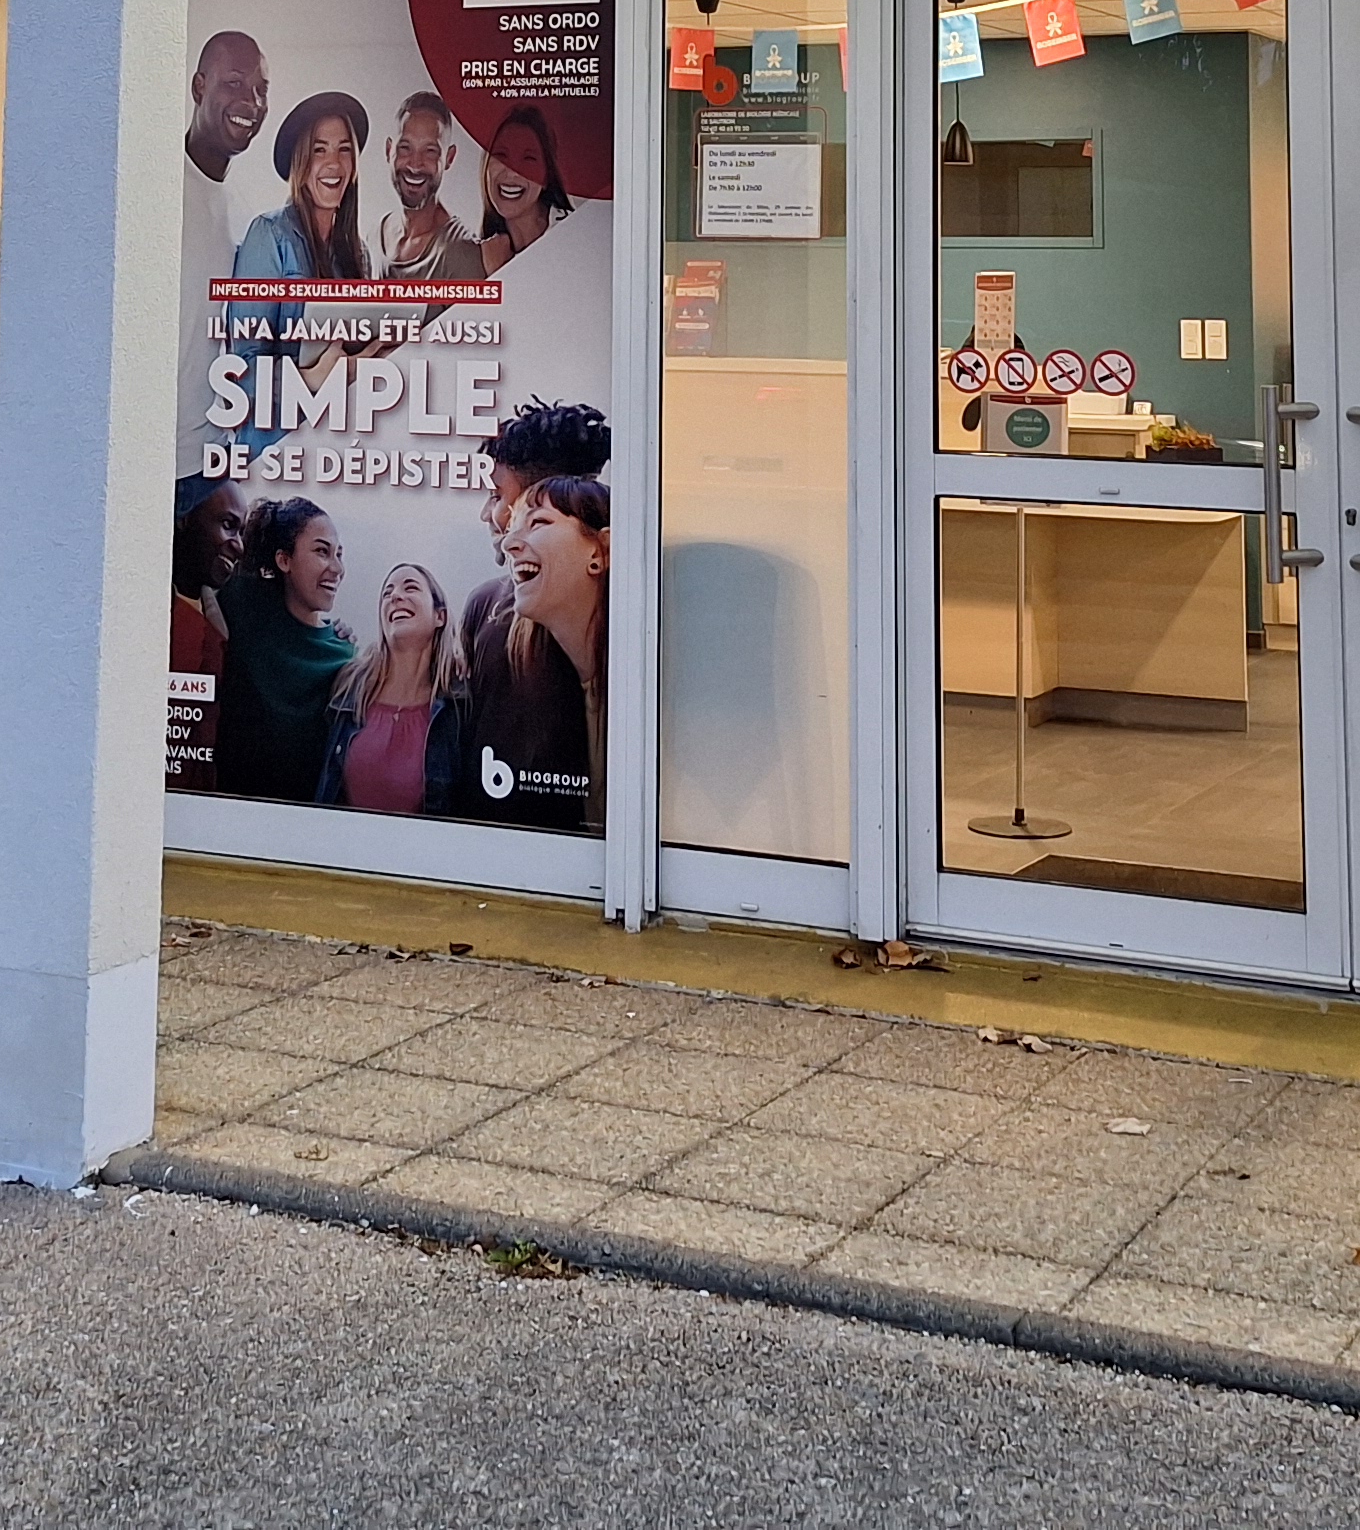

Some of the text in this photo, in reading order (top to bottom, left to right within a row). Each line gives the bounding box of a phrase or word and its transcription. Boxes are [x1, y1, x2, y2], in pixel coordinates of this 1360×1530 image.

[499, 12, 600, 31] SANS ORDO
[513, 35, 600, 53] SANS RDV
[461, 58, 599, 77] PRIS EN CHARGE
[462, 76, 599, 89] (60% PAR L'ASSURANCE MALADIE
[500, 88, 518, 98] 40%
[520, 88, 536, 97] PAR
[538, 88, 549, 96] LA
[551, 86, 600, 96] MUTUELLE)
[211, 282, 500, 300] INFECTIONS SEXUELLEMENT TRANSMISSIBLES
[207, 313, 502, 345] IL N'A JAMAIS ÉTÉ AUSSI
[205, 353, 502, 438] SIMPLE
[202, 439, 498, 491] DE SE DÉPISTER
[168, 679, 207, 694] 6 ANS
[519, 770, 589, 787] BIOGROUP
[519, 783, 550, 794] biologie
